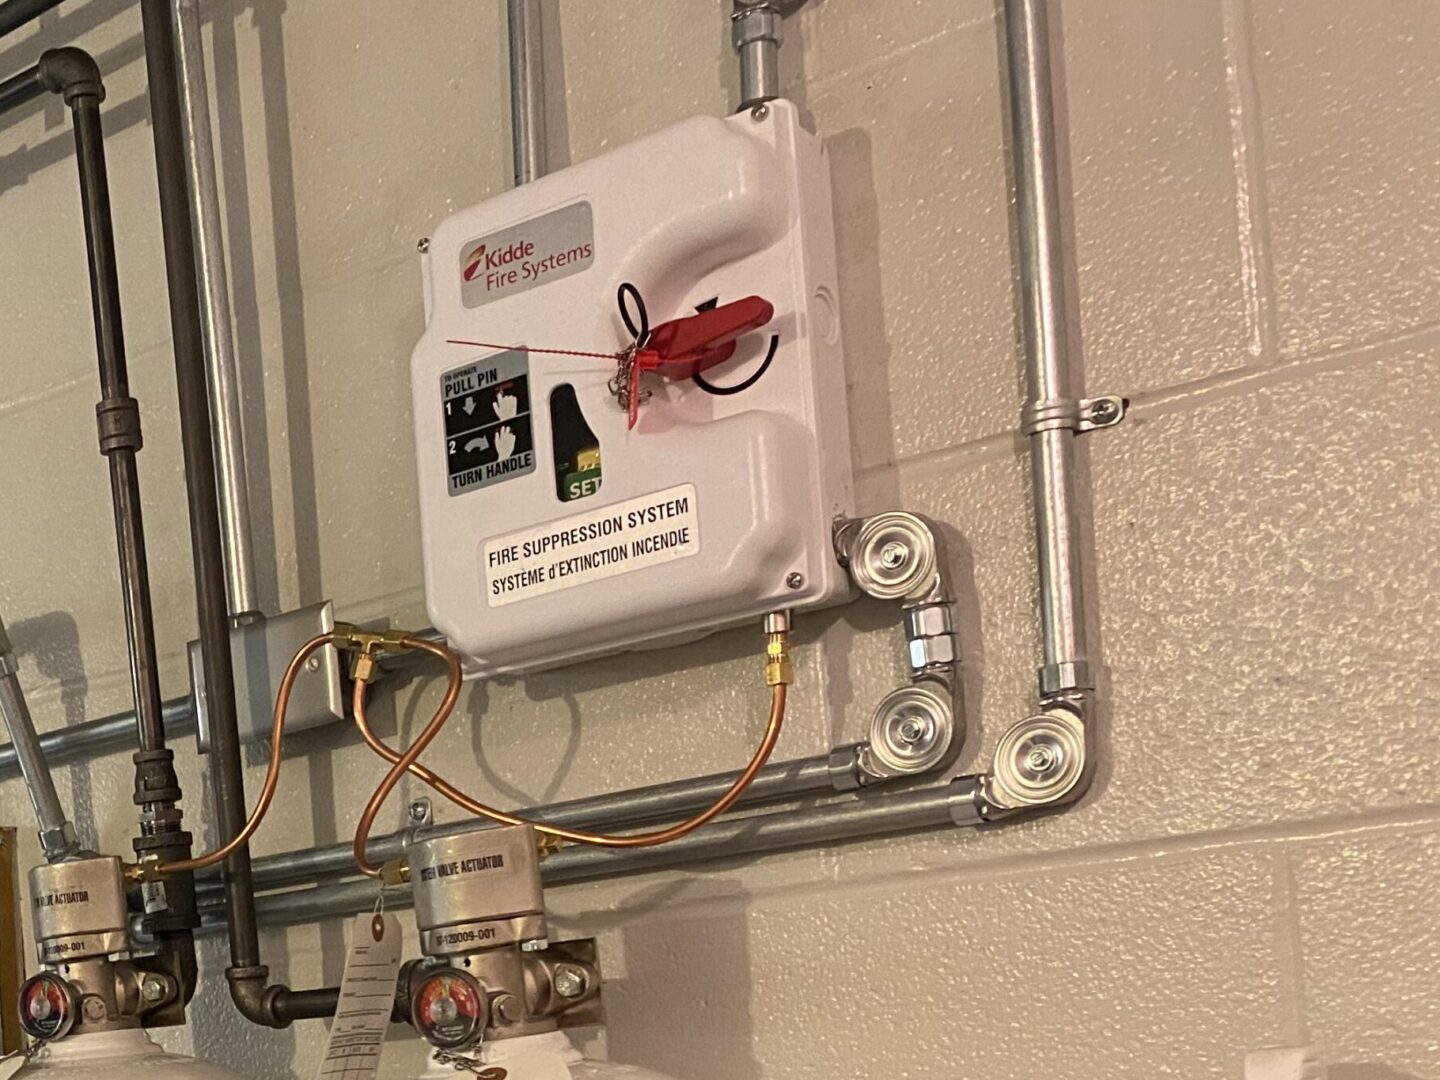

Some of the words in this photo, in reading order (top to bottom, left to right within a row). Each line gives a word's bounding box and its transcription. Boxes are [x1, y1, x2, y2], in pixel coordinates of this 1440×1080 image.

[485, 240, 535, 270] Kidde
[486, 271, 518, 291] Fire
[521, 243, 592, 281] Systems
[445, 377, 474, 397] PULL
[477, 368, 498, 388] PIN
[445, 402, 452, 416] 1
[448, 440, 457, 455] 2
[452, 469, 483, 489] TURN
[486, 453, 532, 479] HANDLE
[570, 478, 602, 499] SET
[489, 545, 519, 568] FIRE
[523, 516, 623, 558] SUPPRESSION
[627, 497, 689, 529] SYSTEM
[492, 566, 545, 595] SYSTÈME
[548, 544, 628, 580] d'EXTINCTION
[632, 527, 690, 557] INCENDIE
[461, 854, 504, 873] ACTUATOR
